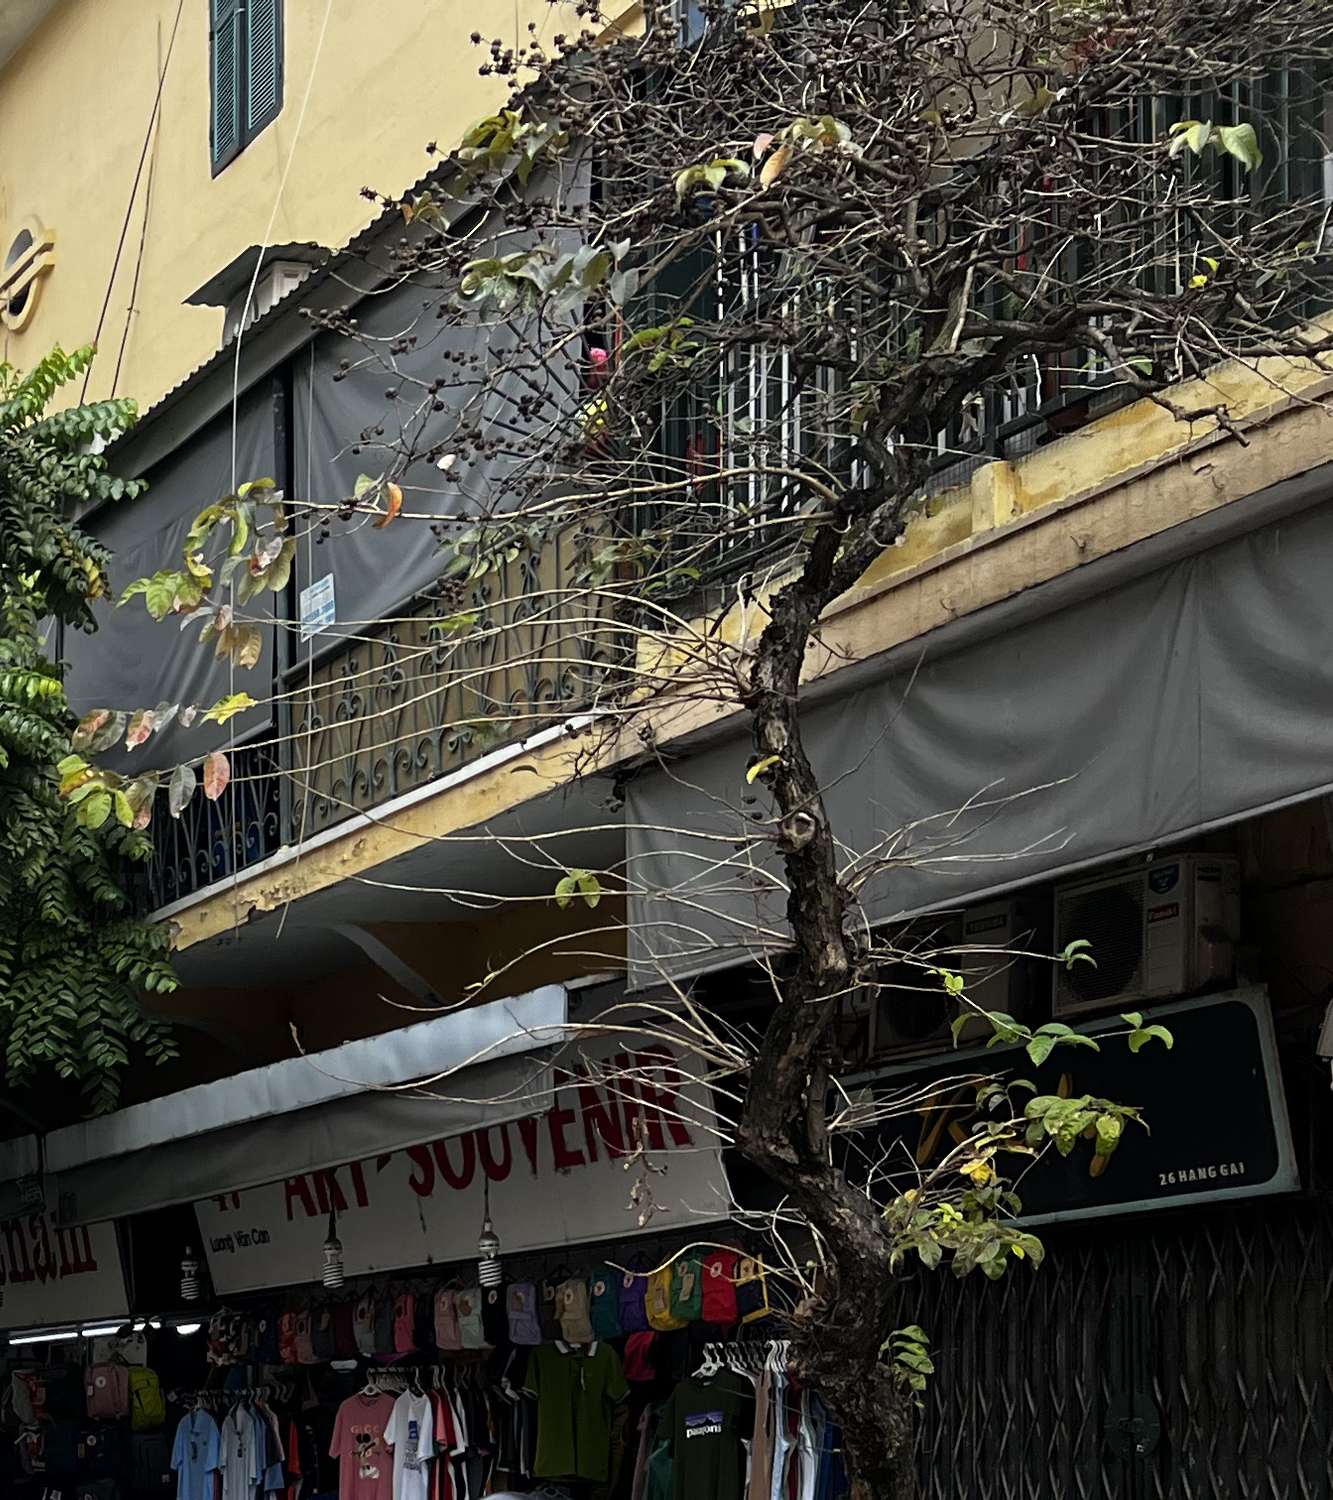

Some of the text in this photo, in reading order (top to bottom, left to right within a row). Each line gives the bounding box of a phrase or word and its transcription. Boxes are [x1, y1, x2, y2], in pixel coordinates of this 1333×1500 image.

[1158, 1161, 1245, 1186] 26 HANG GAI
